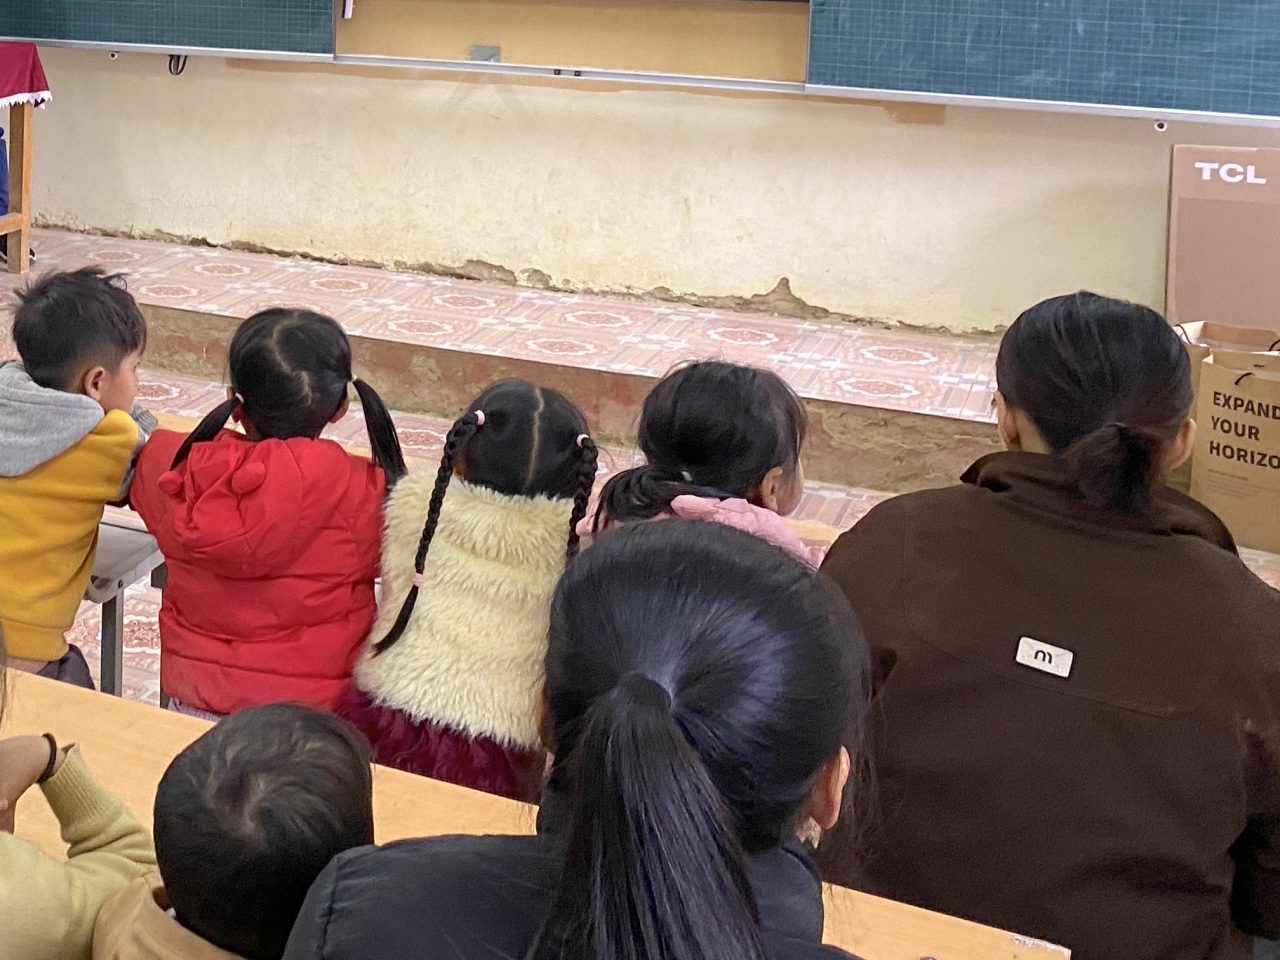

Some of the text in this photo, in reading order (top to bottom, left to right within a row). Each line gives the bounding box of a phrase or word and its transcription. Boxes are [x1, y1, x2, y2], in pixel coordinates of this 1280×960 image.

[1194, 162, 1266, 184] TCL
[1213, 391, 1280, 420] EXPAND
[1211, 415, 1259, 440] YOUR
[1210, 440, 1280, 469] HORIZO
